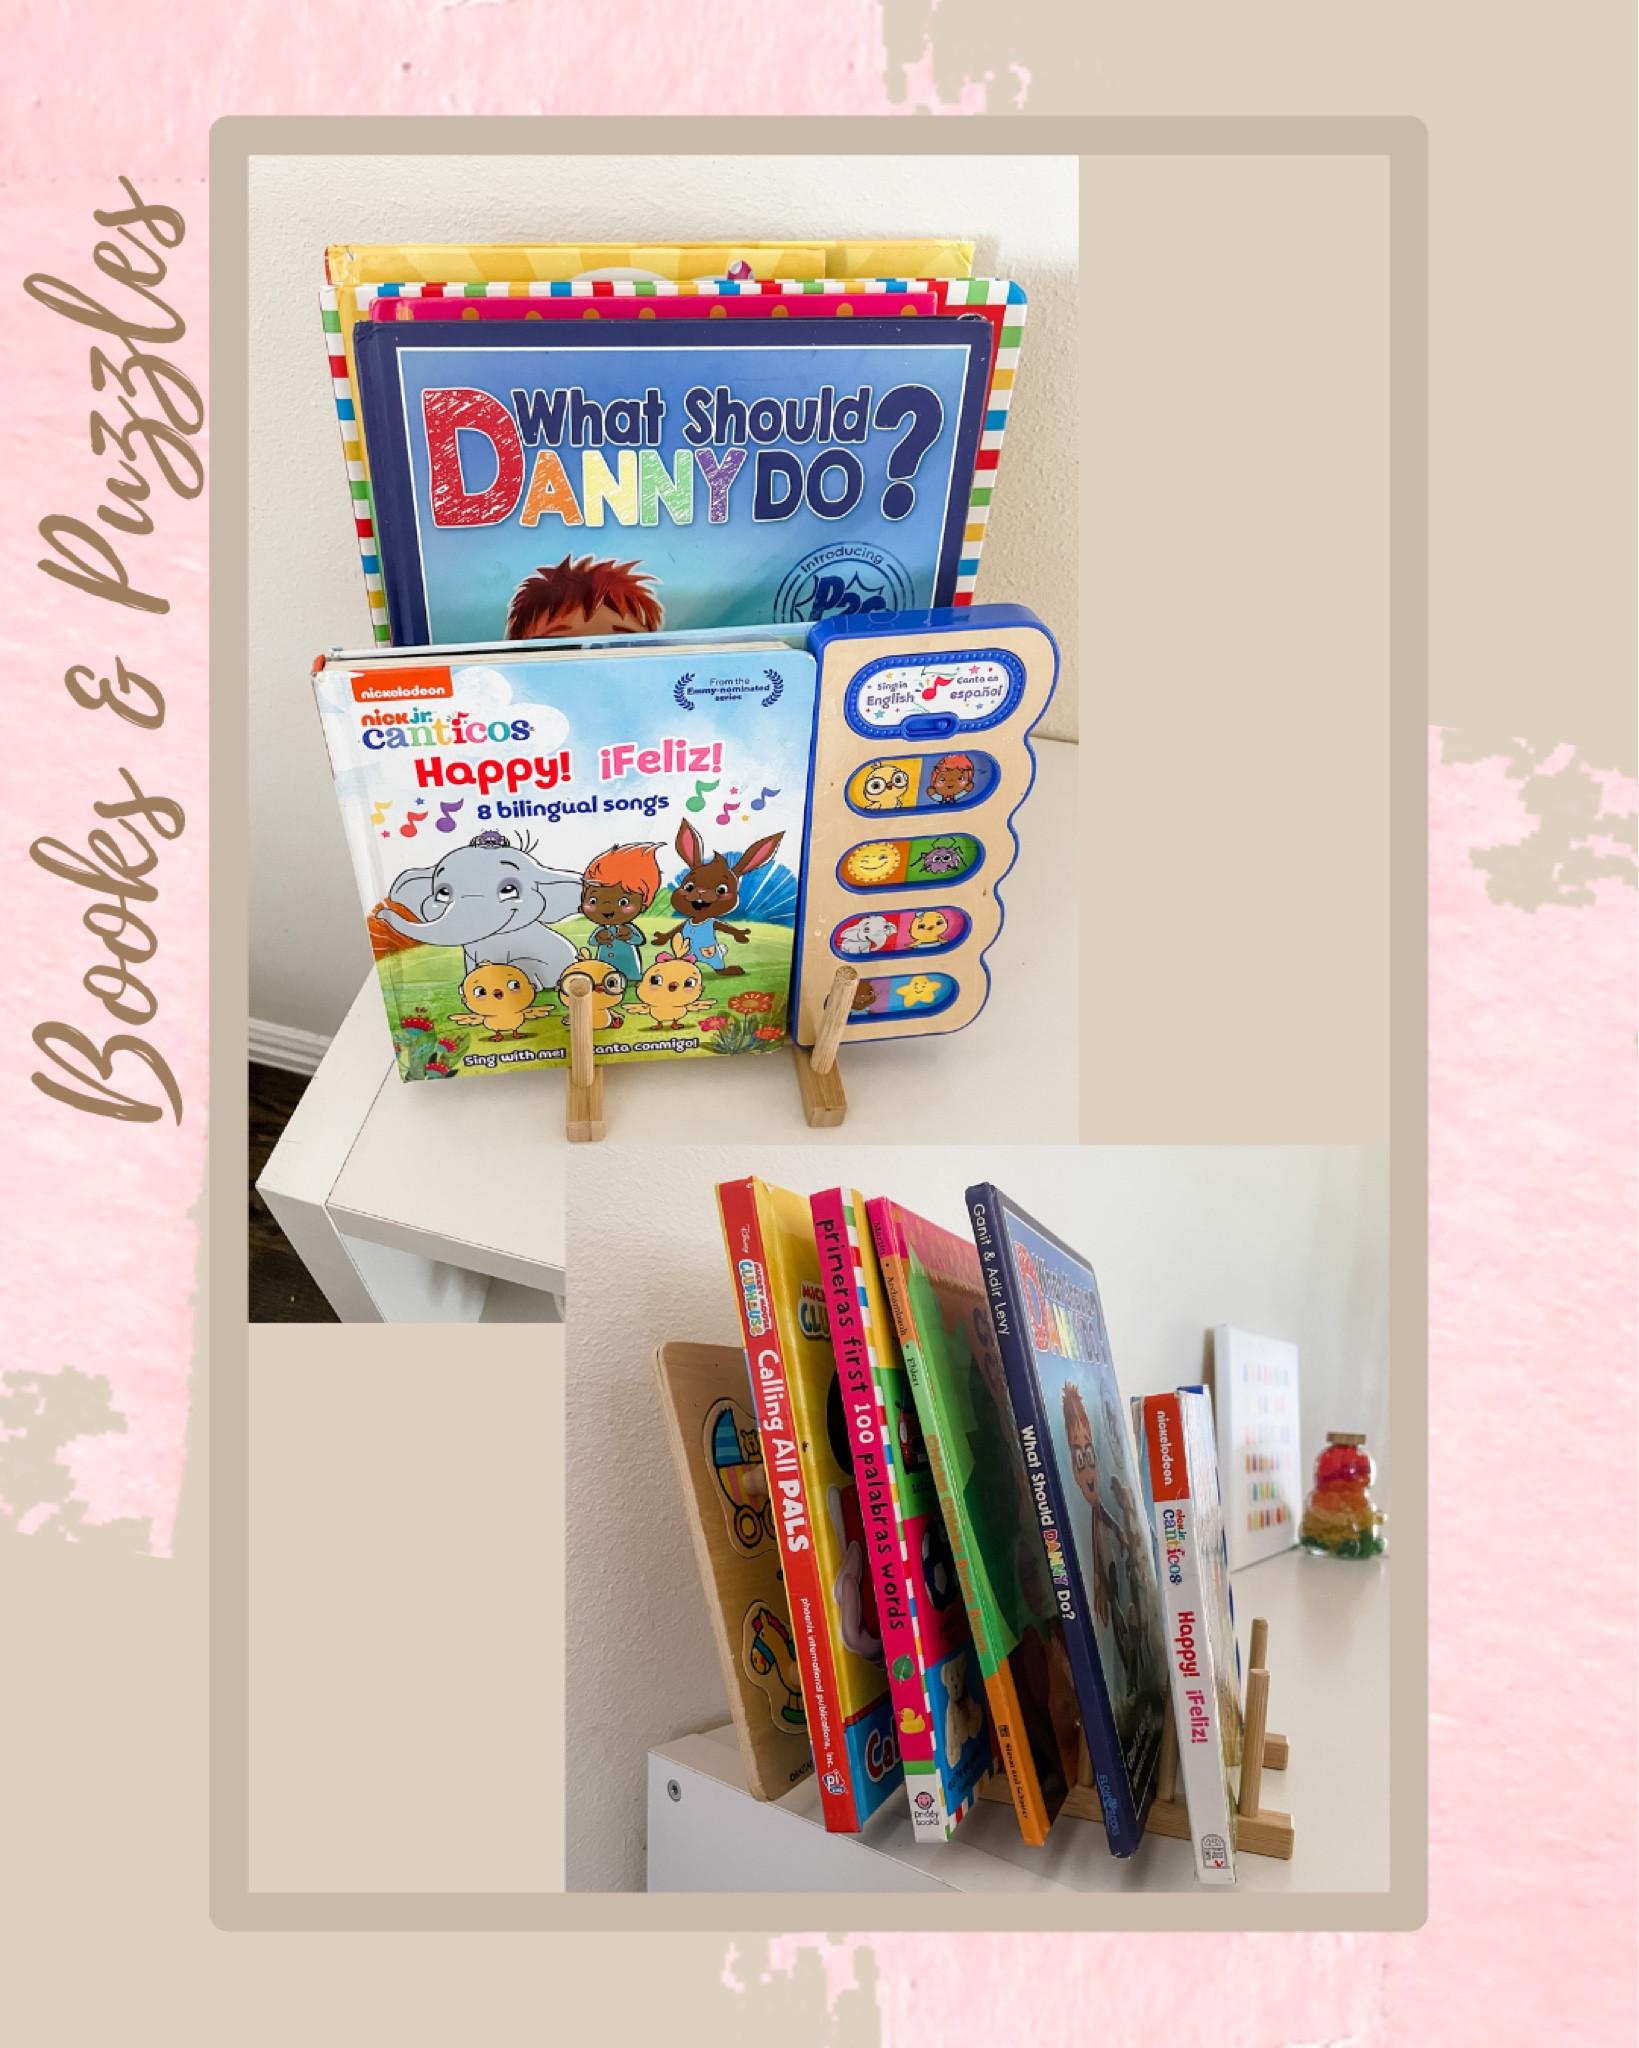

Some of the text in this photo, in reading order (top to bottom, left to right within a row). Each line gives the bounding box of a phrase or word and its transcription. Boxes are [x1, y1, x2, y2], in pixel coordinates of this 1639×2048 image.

[512, 385, 872, 447] What Should
[422, 387, 747, 529] DANNY
[801, 546, 884, 574] Introducing
[361, 684, 446, 699] nickelodeon
[686, 684, 771, 695] Emmy-nominated
[709, 677, 750, 686] From the
[949, 684, 1004, 702] español
[957, 675, 985, 684] Canta
[715, 693, 742, 701] series
[866, 691, 914, 709] English
[414, 741, 723, 795] Happy! ¡Feliz!
[477, 795, 670, 823] 8 bilingual songs
[464, 1037, 699, 1067] Sing with me! anta conmigo!
[874, 1222, 886, 1254] Martin
[973, 1203, 993, 1245] Ganit
[983, 1250, 996, 1261] &
[987, 1267, 1003, 1298] Adir
[994, 1302, 1010, 1336] Levy
[816, 1219, 905, 1630] primeras first 100 palabras words
[757, 1349, 809, 1554] Calling All PALS
[1157, 1410, 1174, 1486] nickelodeon
[1021, 1425, 1076, 1620] What Should DANNY Do?
[925, 1434, 948, 1493] Chicka
[940, 1496, 964, 1555] Chicka
[956, 1558, 975, 1604] Boom
[968, 1607, 988, 1655] Boom
[800, 1597, 813, 1634] phoenix
[807, 1635, 824, 1692] international
[1173, 1610, 1209, 1745] Happy! ¡Feliz!
[815, 1693, 831, 1750] publications,
